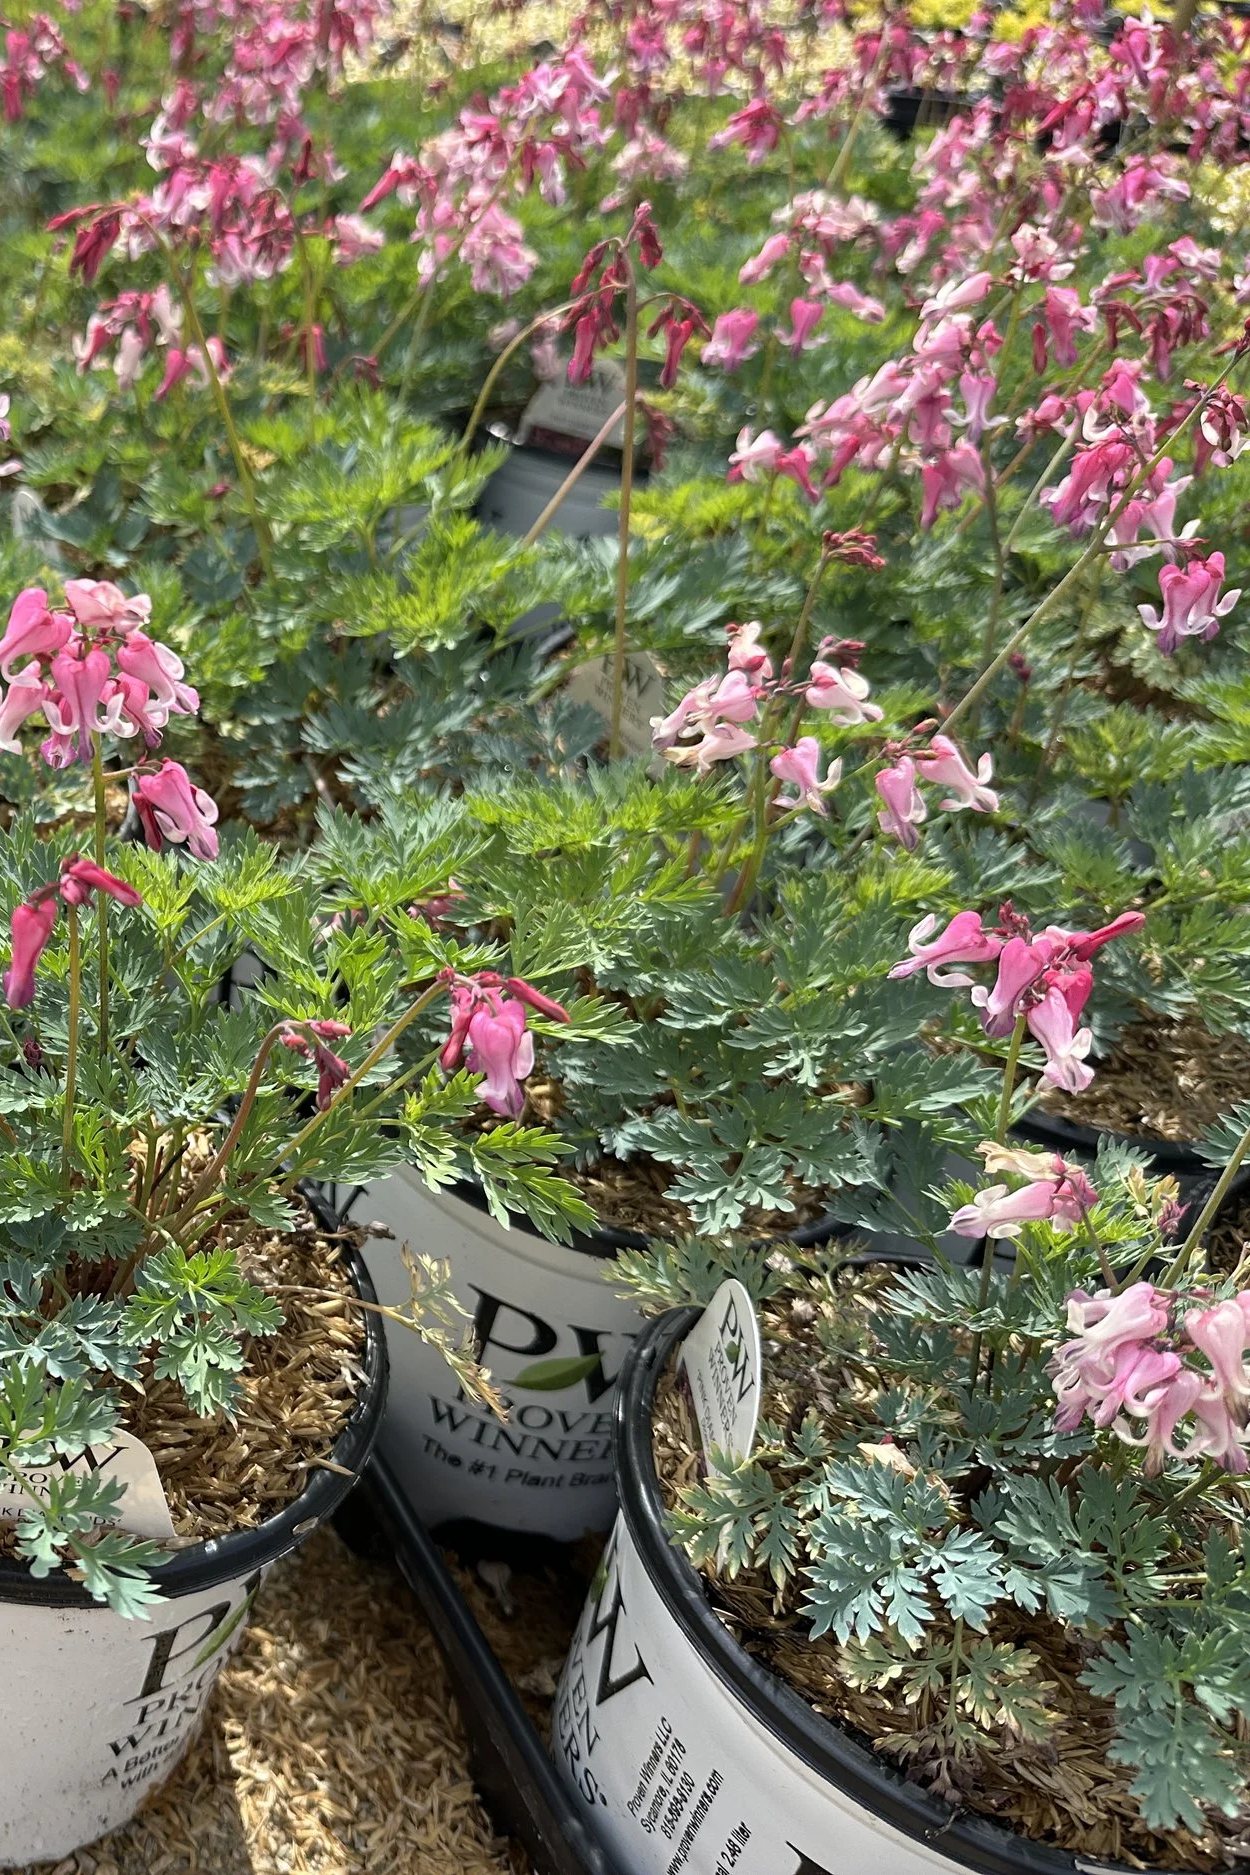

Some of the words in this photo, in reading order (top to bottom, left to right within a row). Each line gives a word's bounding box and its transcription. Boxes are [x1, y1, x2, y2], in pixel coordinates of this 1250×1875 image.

[422, 1433, 463, 1467] The
[468, 1457, 497, 1480] #1
[504, 1467, 566, 1488] Plant
[626, 1780, 648, 1818] Proven
[639, 1738, 665, 1785] Winners
[657, 1716, 673, 1748] LLC
[640, 1785, 671, 1834] Sycamore,
[664, 1737, 687, 1777] 60178
